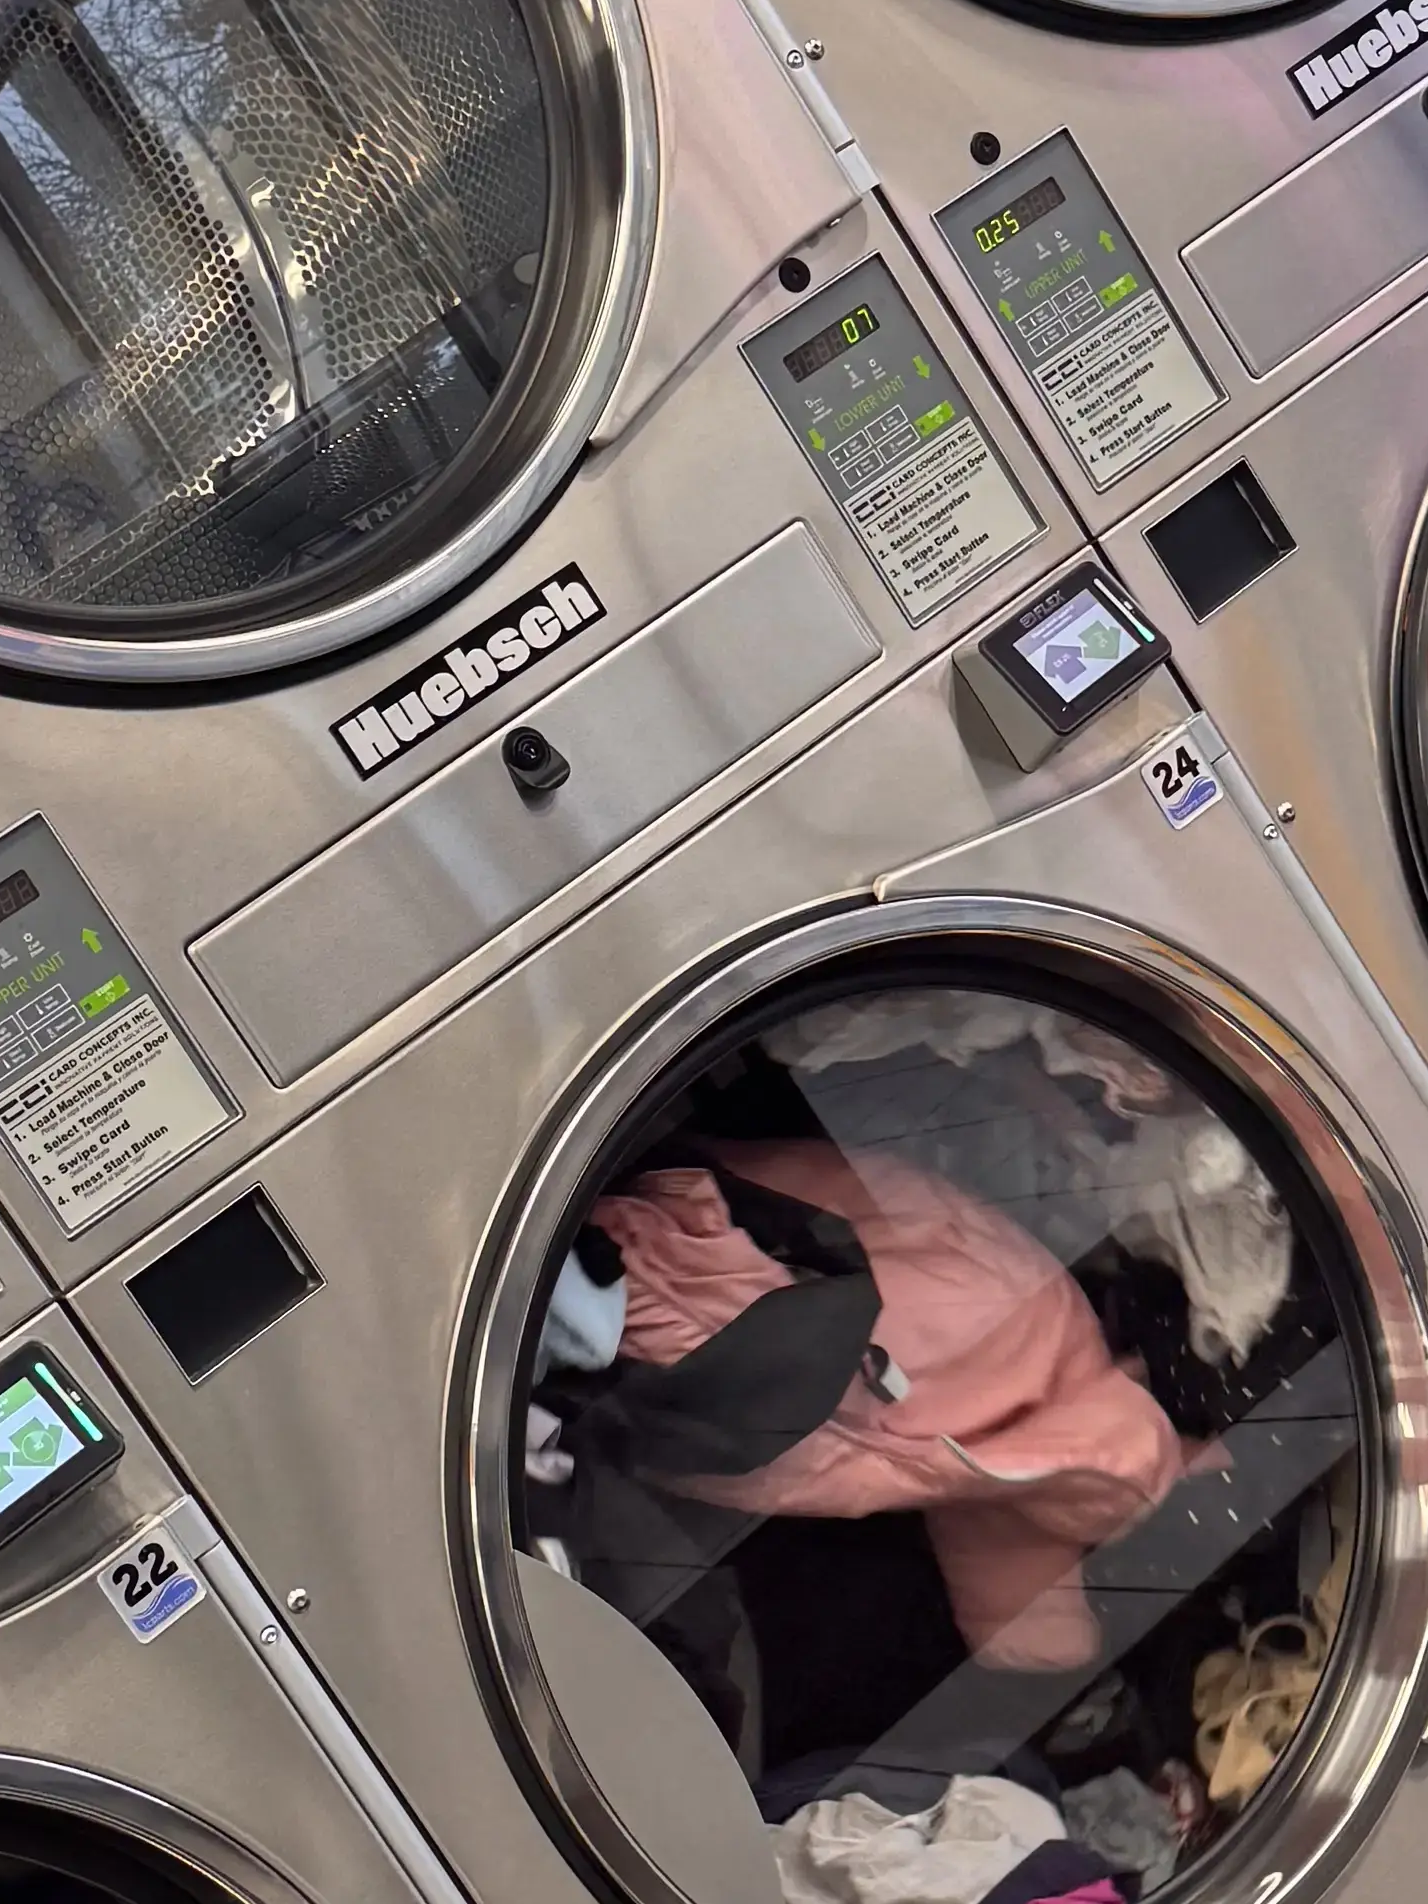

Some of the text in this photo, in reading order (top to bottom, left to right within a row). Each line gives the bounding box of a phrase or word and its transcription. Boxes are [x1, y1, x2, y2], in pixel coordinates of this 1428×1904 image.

[971, 206, 1023, 254] 0.25
[338, 581, 600, 772] Huebsch
[1152, 746, 1200, 798] 24
[29, 951, 67, 983] UNIT
[47, 1005, 154, 1082] CARD CONCEPTS INC.
[27, 1107, 57, 1132] Load
[55, 1076, 102, 1113] Machine
[100, 1069, 113, 1082] &
[111, 1047, 144, 1074] Close
[142, 1029, 170, 1053] Door
[42, 1123, 79, 1154] Select
[77, 1076, 148, 1130] Temperature
[56, 1140, 100, 1176] Swipe
[98, 1118, 131, 1146] Card
[71, 1168, 104, 1196] Press
[102, 1148, 132, 1174] Start
[130, 1122, 169, 1154] Button
[112, 1542, 179, 1608] 22
